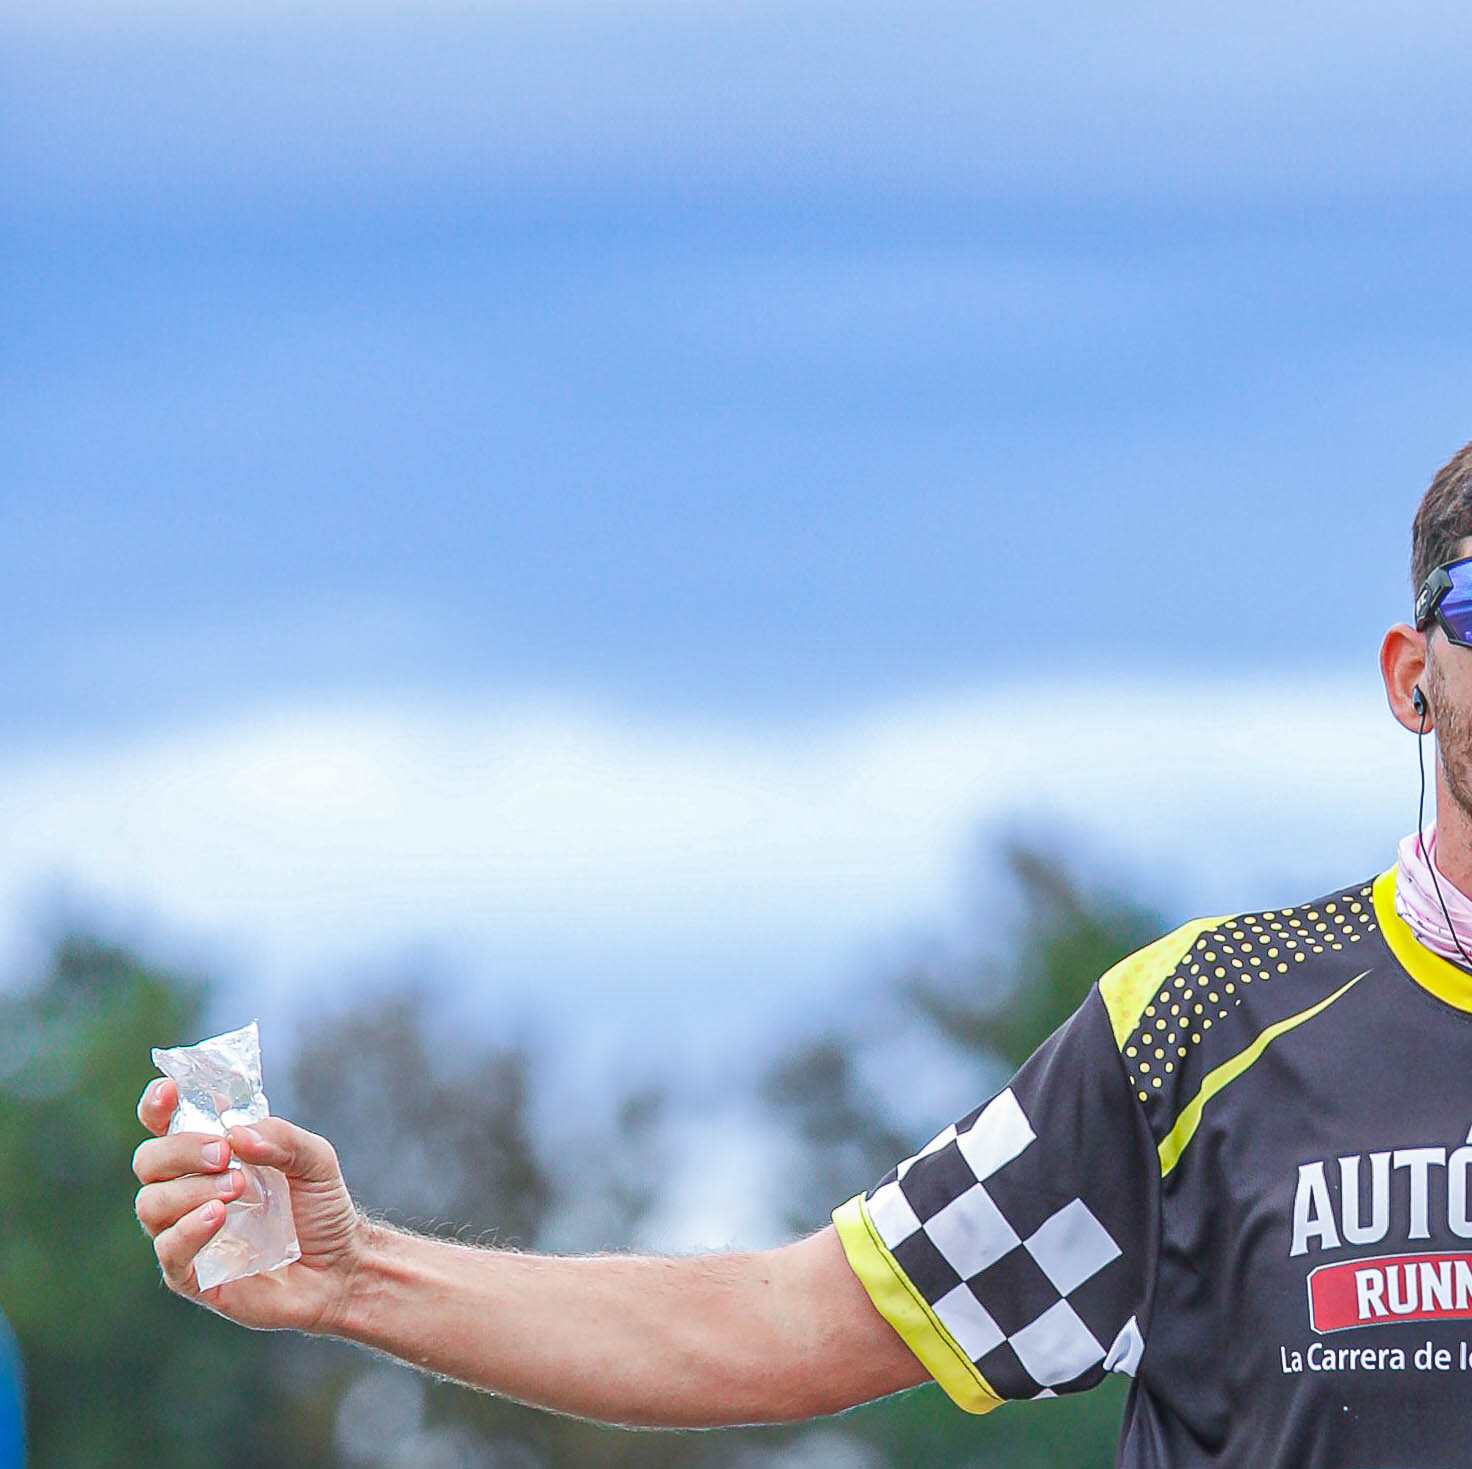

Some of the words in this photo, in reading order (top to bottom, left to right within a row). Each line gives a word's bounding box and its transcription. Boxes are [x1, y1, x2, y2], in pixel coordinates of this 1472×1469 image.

[1280, 1346, 1303, 1373] La
[1306, 1342, 1405, 1371] Carrera
[1414, 1341, 1450, 1370] de
